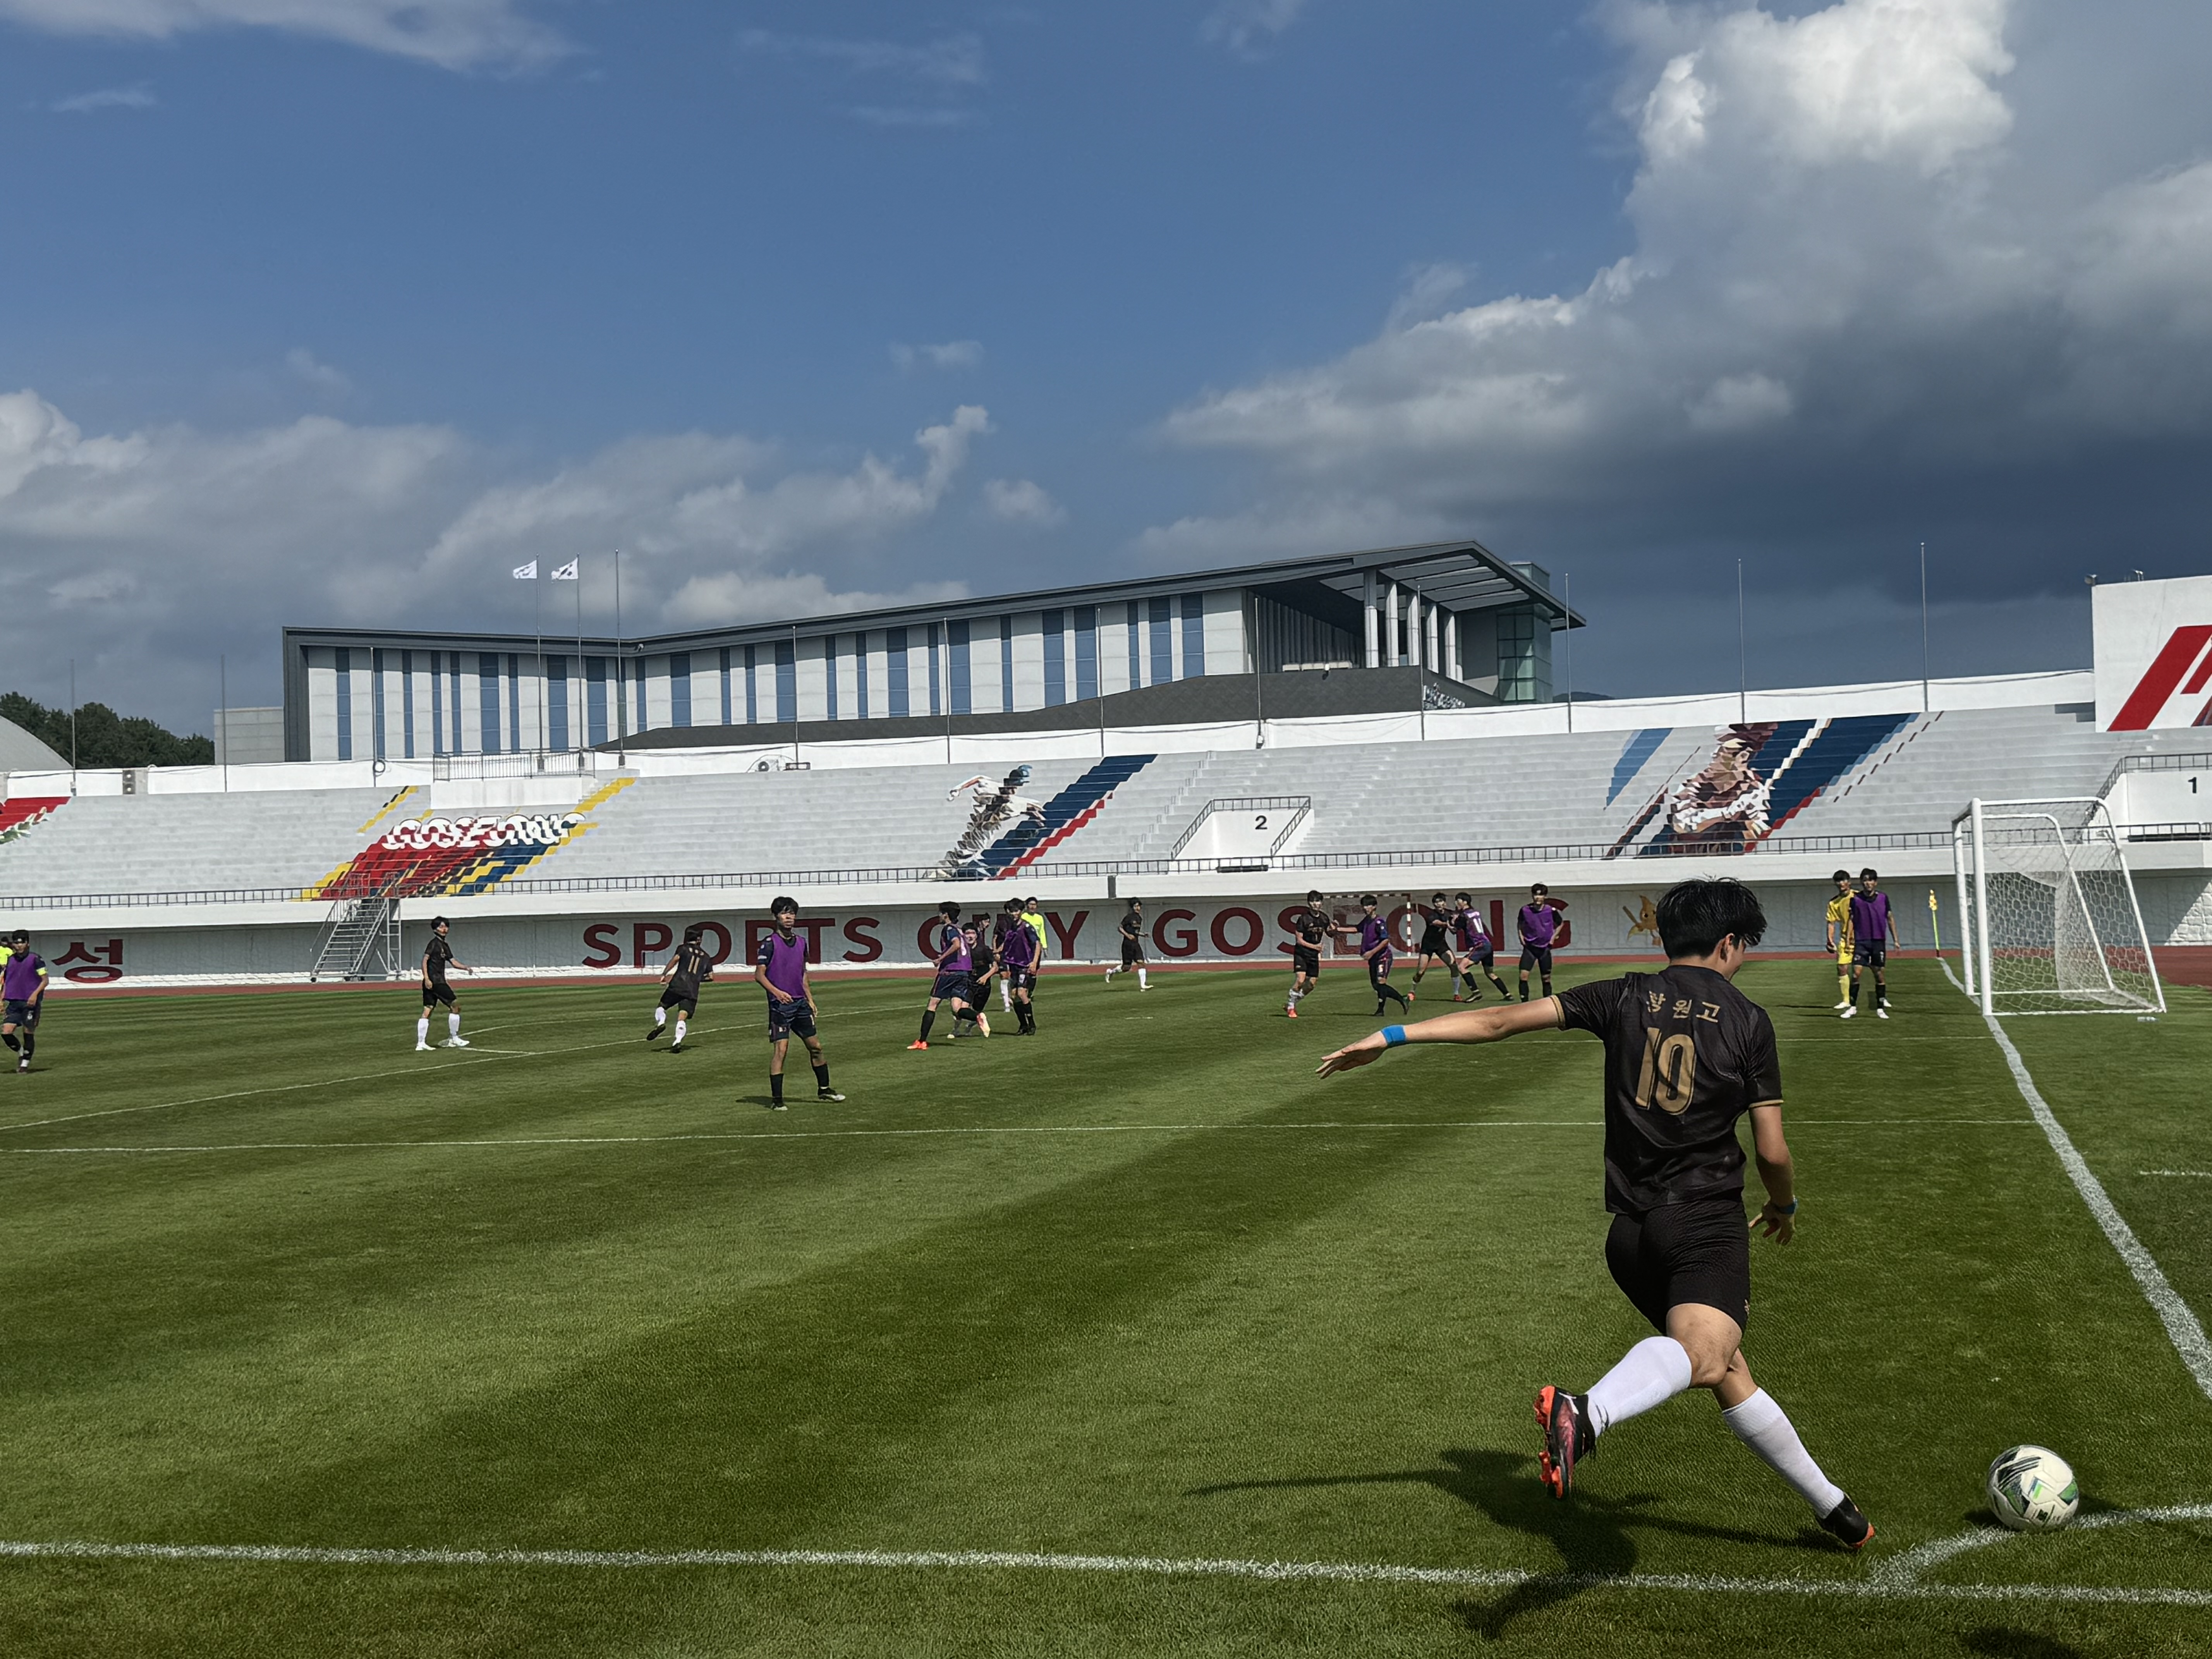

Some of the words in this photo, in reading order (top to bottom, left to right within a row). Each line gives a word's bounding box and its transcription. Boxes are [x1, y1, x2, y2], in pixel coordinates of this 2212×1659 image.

[2188, 777, 2197, 793] 1
[1255, 815, 1268, 830] 2
[688, 955, 700, 974] 11
[1635, 1027, 1697, 1116] 10
